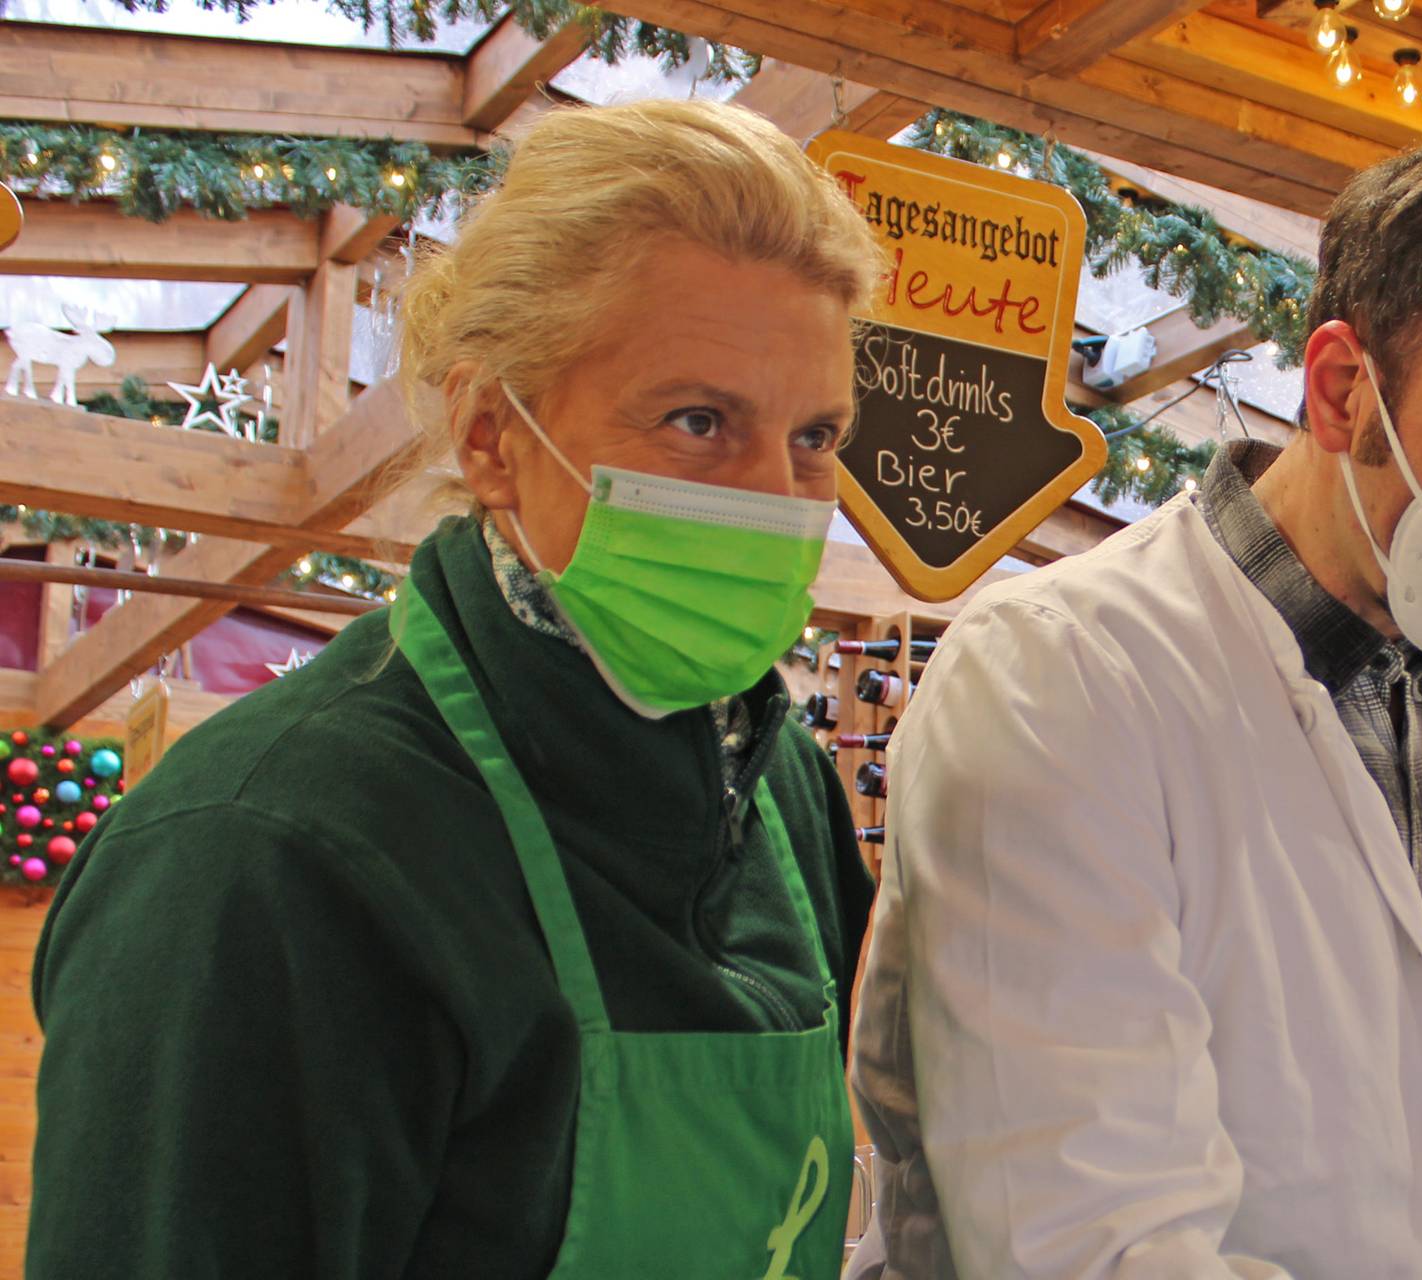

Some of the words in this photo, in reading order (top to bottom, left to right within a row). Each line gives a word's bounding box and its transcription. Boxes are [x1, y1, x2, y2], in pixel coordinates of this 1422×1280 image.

[834, 170, 1060, 268] Tagesangebot
[911, 408, 966, 453] 3€
[877, 449, 968, 494] Bier
